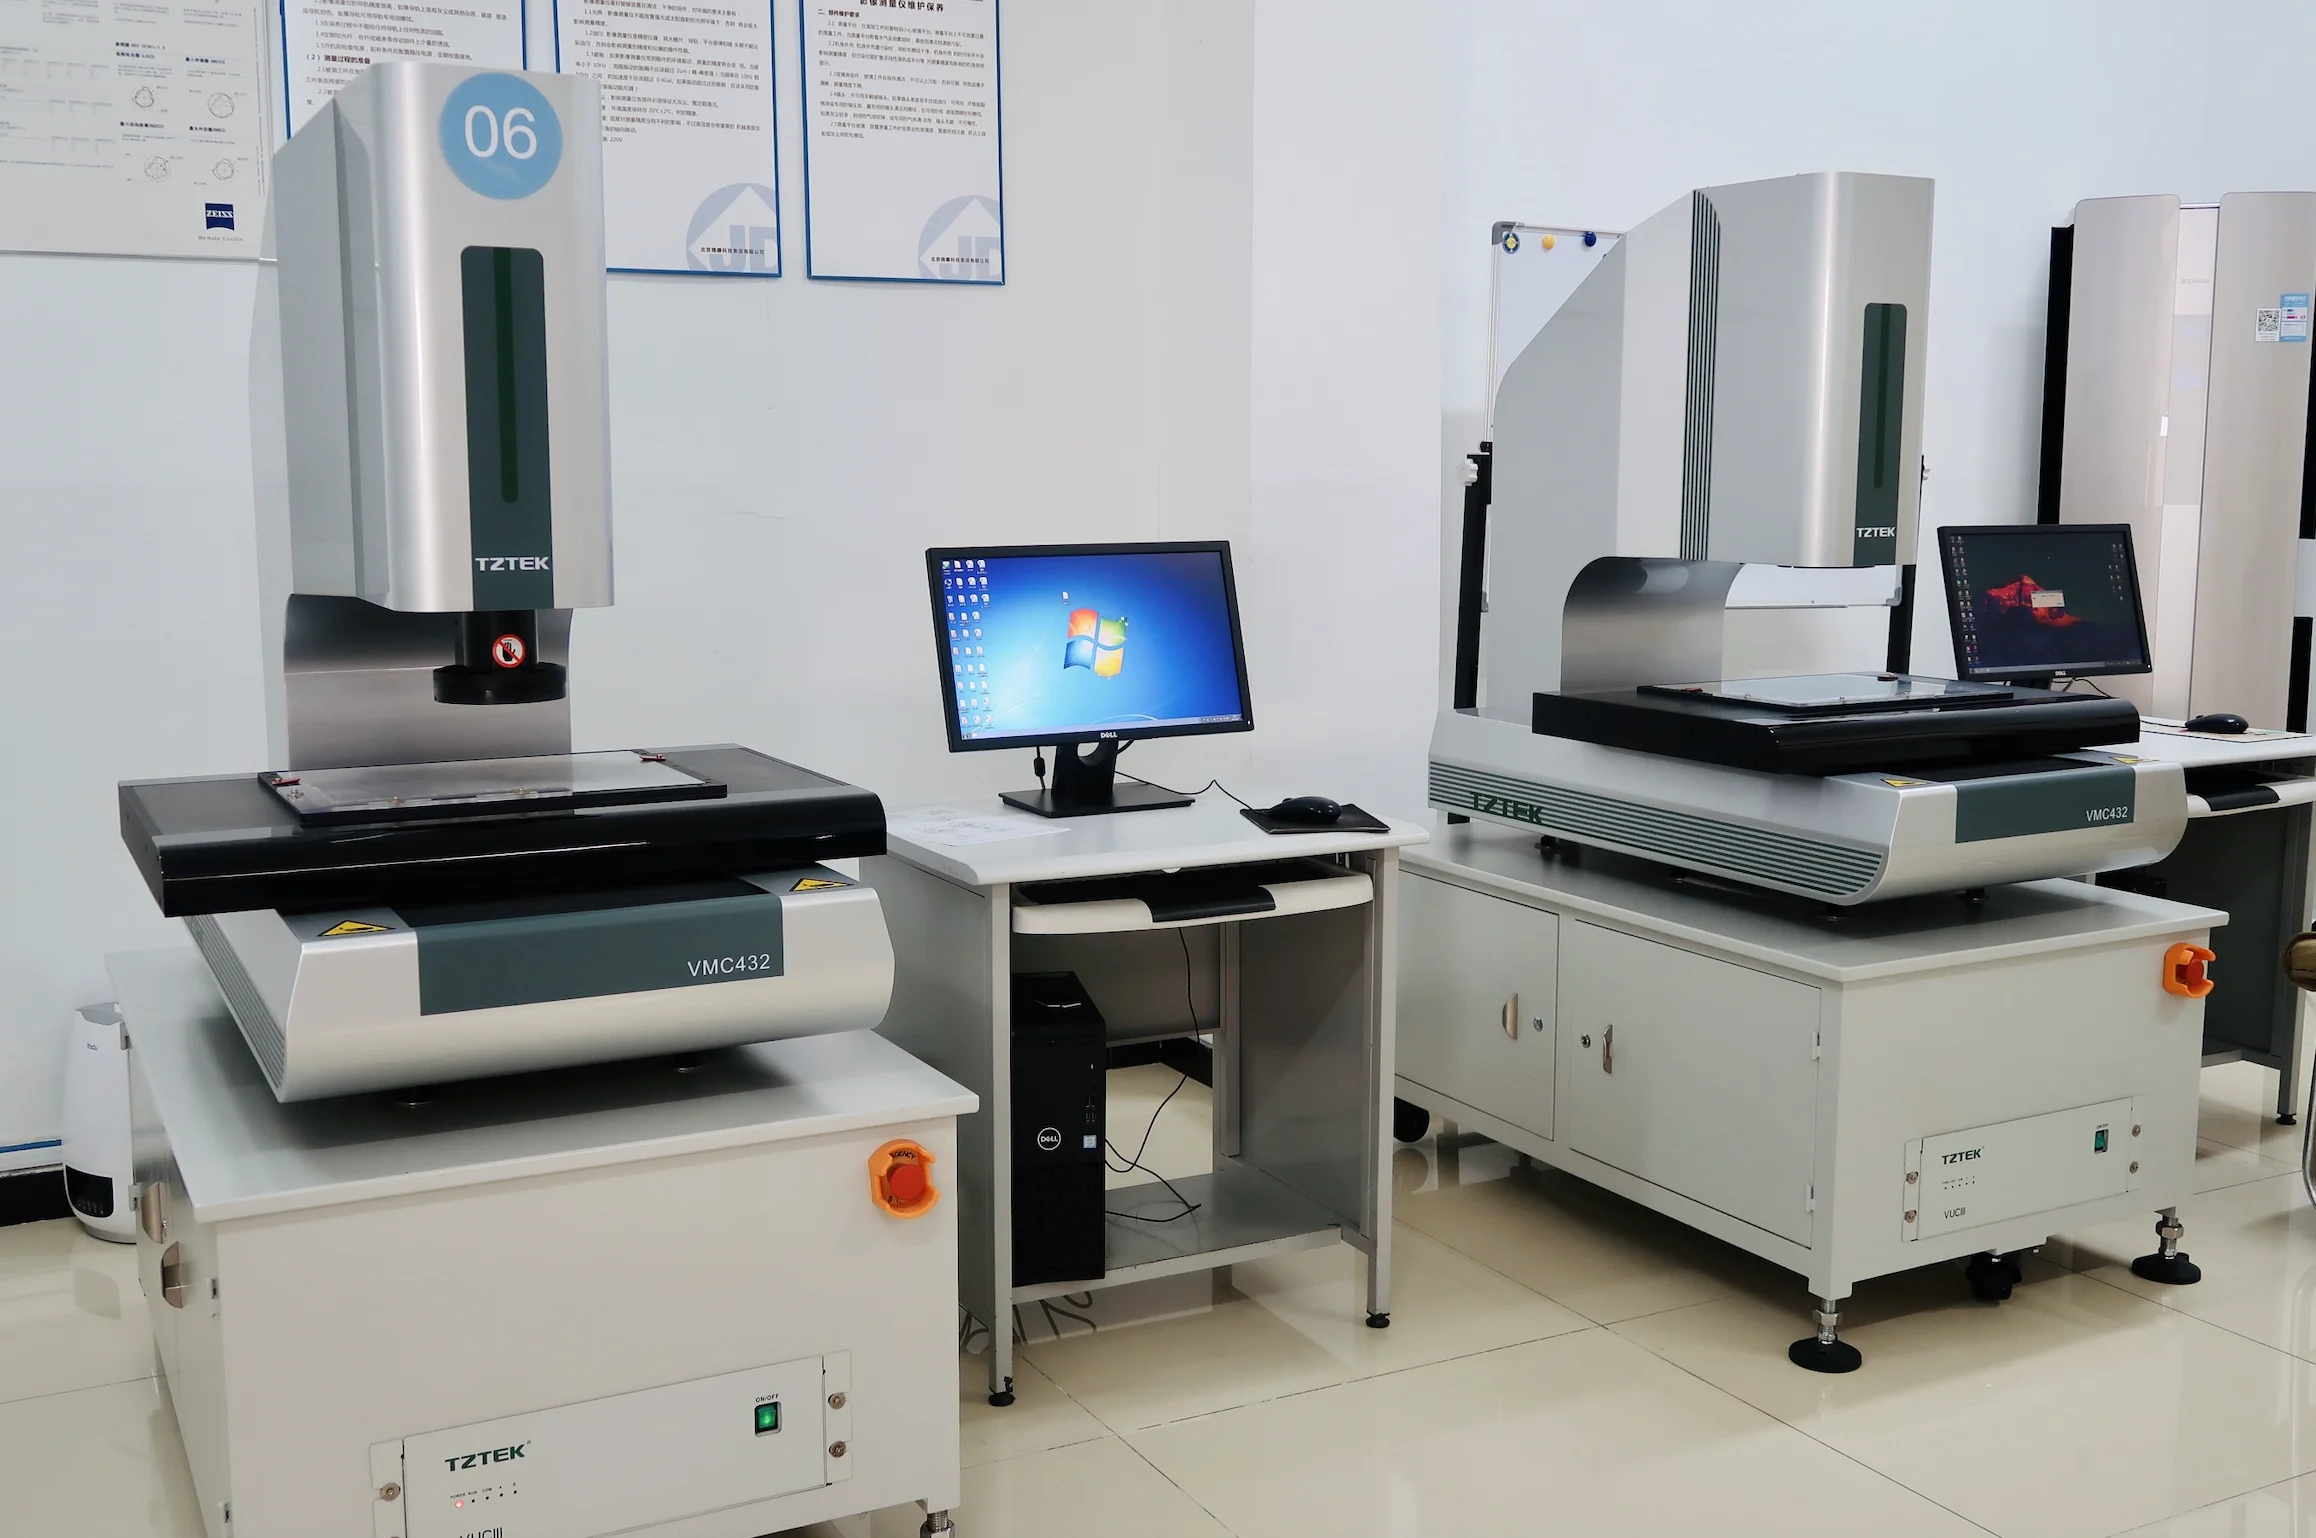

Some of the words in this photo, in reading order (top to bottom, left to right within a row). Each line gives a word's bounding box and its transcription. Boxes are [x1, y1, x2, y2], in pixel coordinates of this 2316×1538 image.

[860, 0, 944, 12] 影像测量仪维护保养
[464, 105, 537, 160] 06
[206, 210, 234, 218] ZEISS
[1856, 526, 1896, 539] TZTEK
[475, 556, 550, 571] TZTEK
[1469, 791, 1544, 824] TZTEK
[2086, 806, 2129, 821] VMC432
[687, 953, 771, 977] VMC432
[1040, 1135, 1059, 1143] DELL
[1942, 1148, 1981, 1165] TZTEK
[755, 1393, 779, 1403] ON/OFF
[444, 1444, 526, 1472] TZTEK
